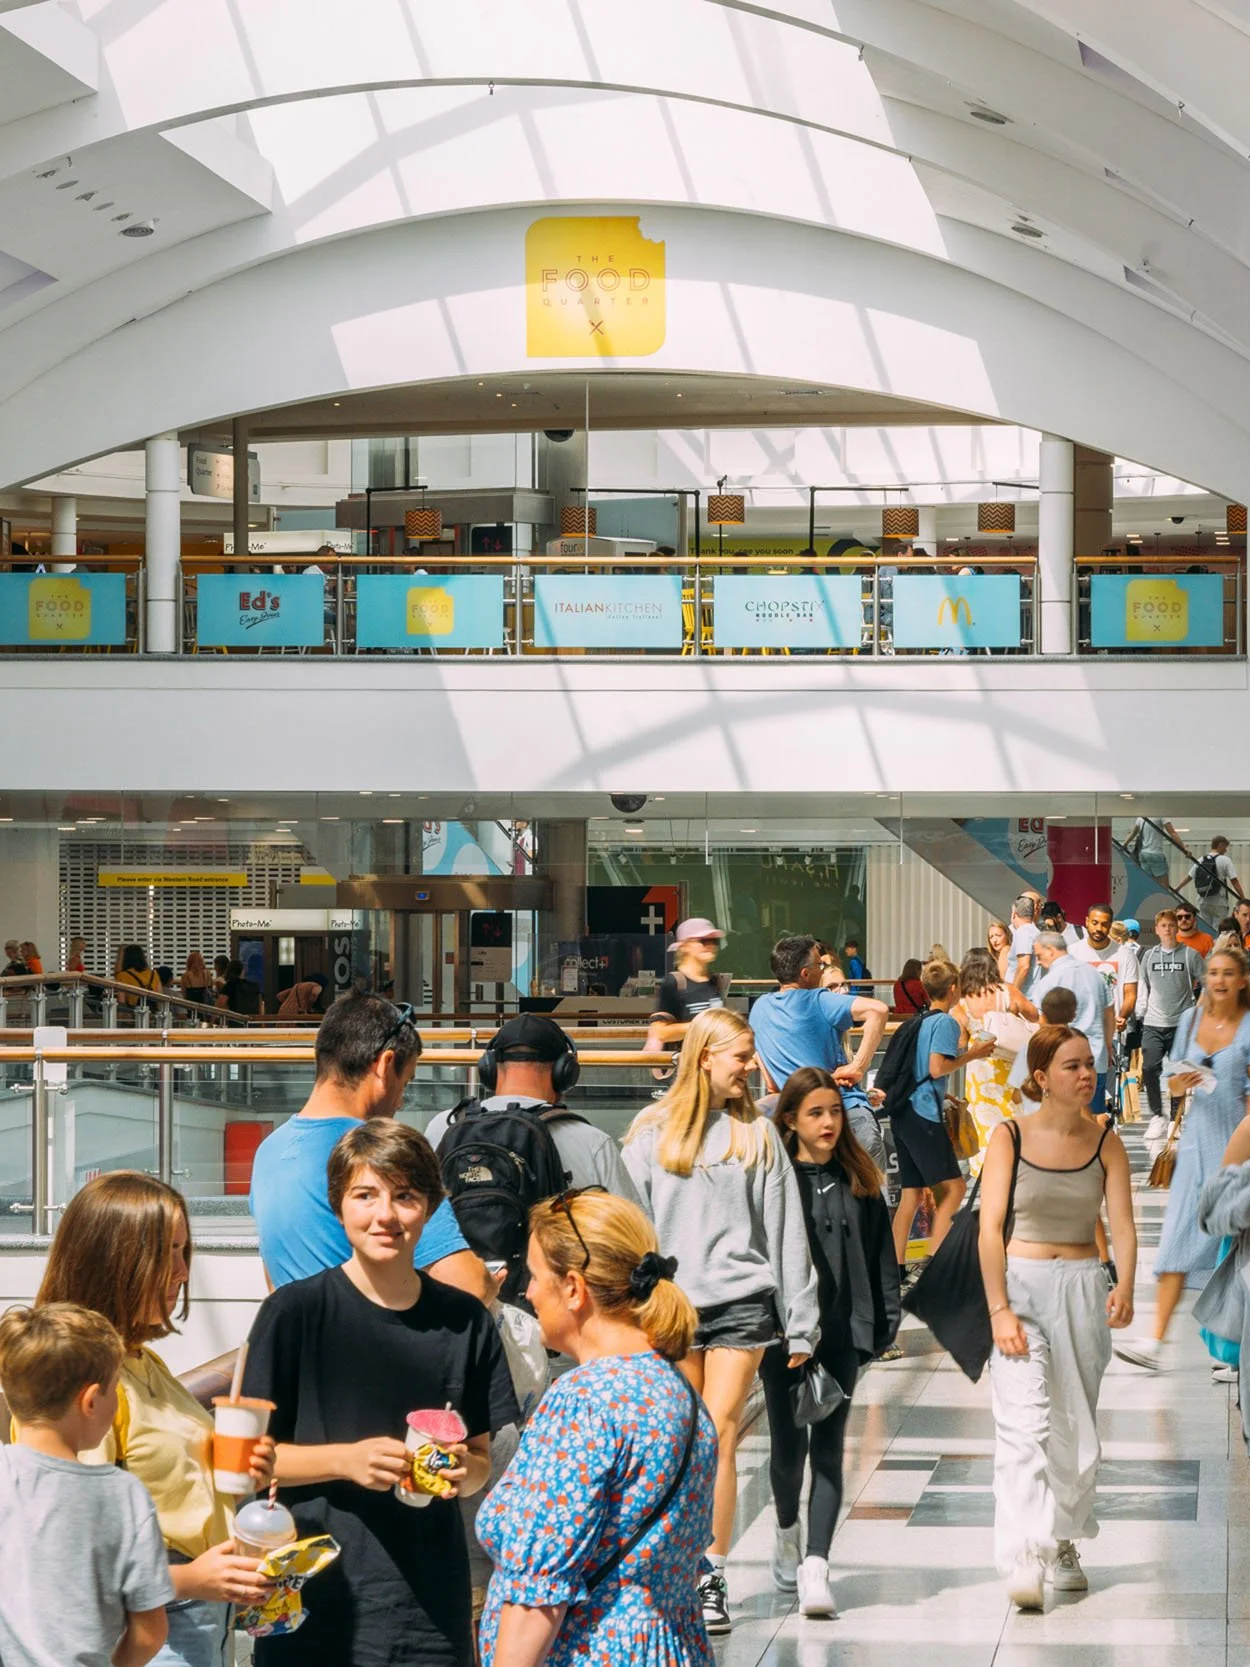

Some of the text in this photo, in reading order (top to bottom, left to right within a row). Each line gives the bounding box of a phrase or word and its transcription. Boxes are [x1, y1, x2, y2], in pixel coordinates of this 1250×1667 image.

[576, 255, 615, 263] THE
[542, 268, 650, 292] FOOD
[543, 297, 648, 307] QUARTER
[239, 590, 281, 611] Ed's
[745, 600, 825, 612] CHOPSTIX
[35, 601, 84, 612] FOOD
[1133, 602, 1182, 613] FOOD
[232, 919, 271, 928] Photo-Me
